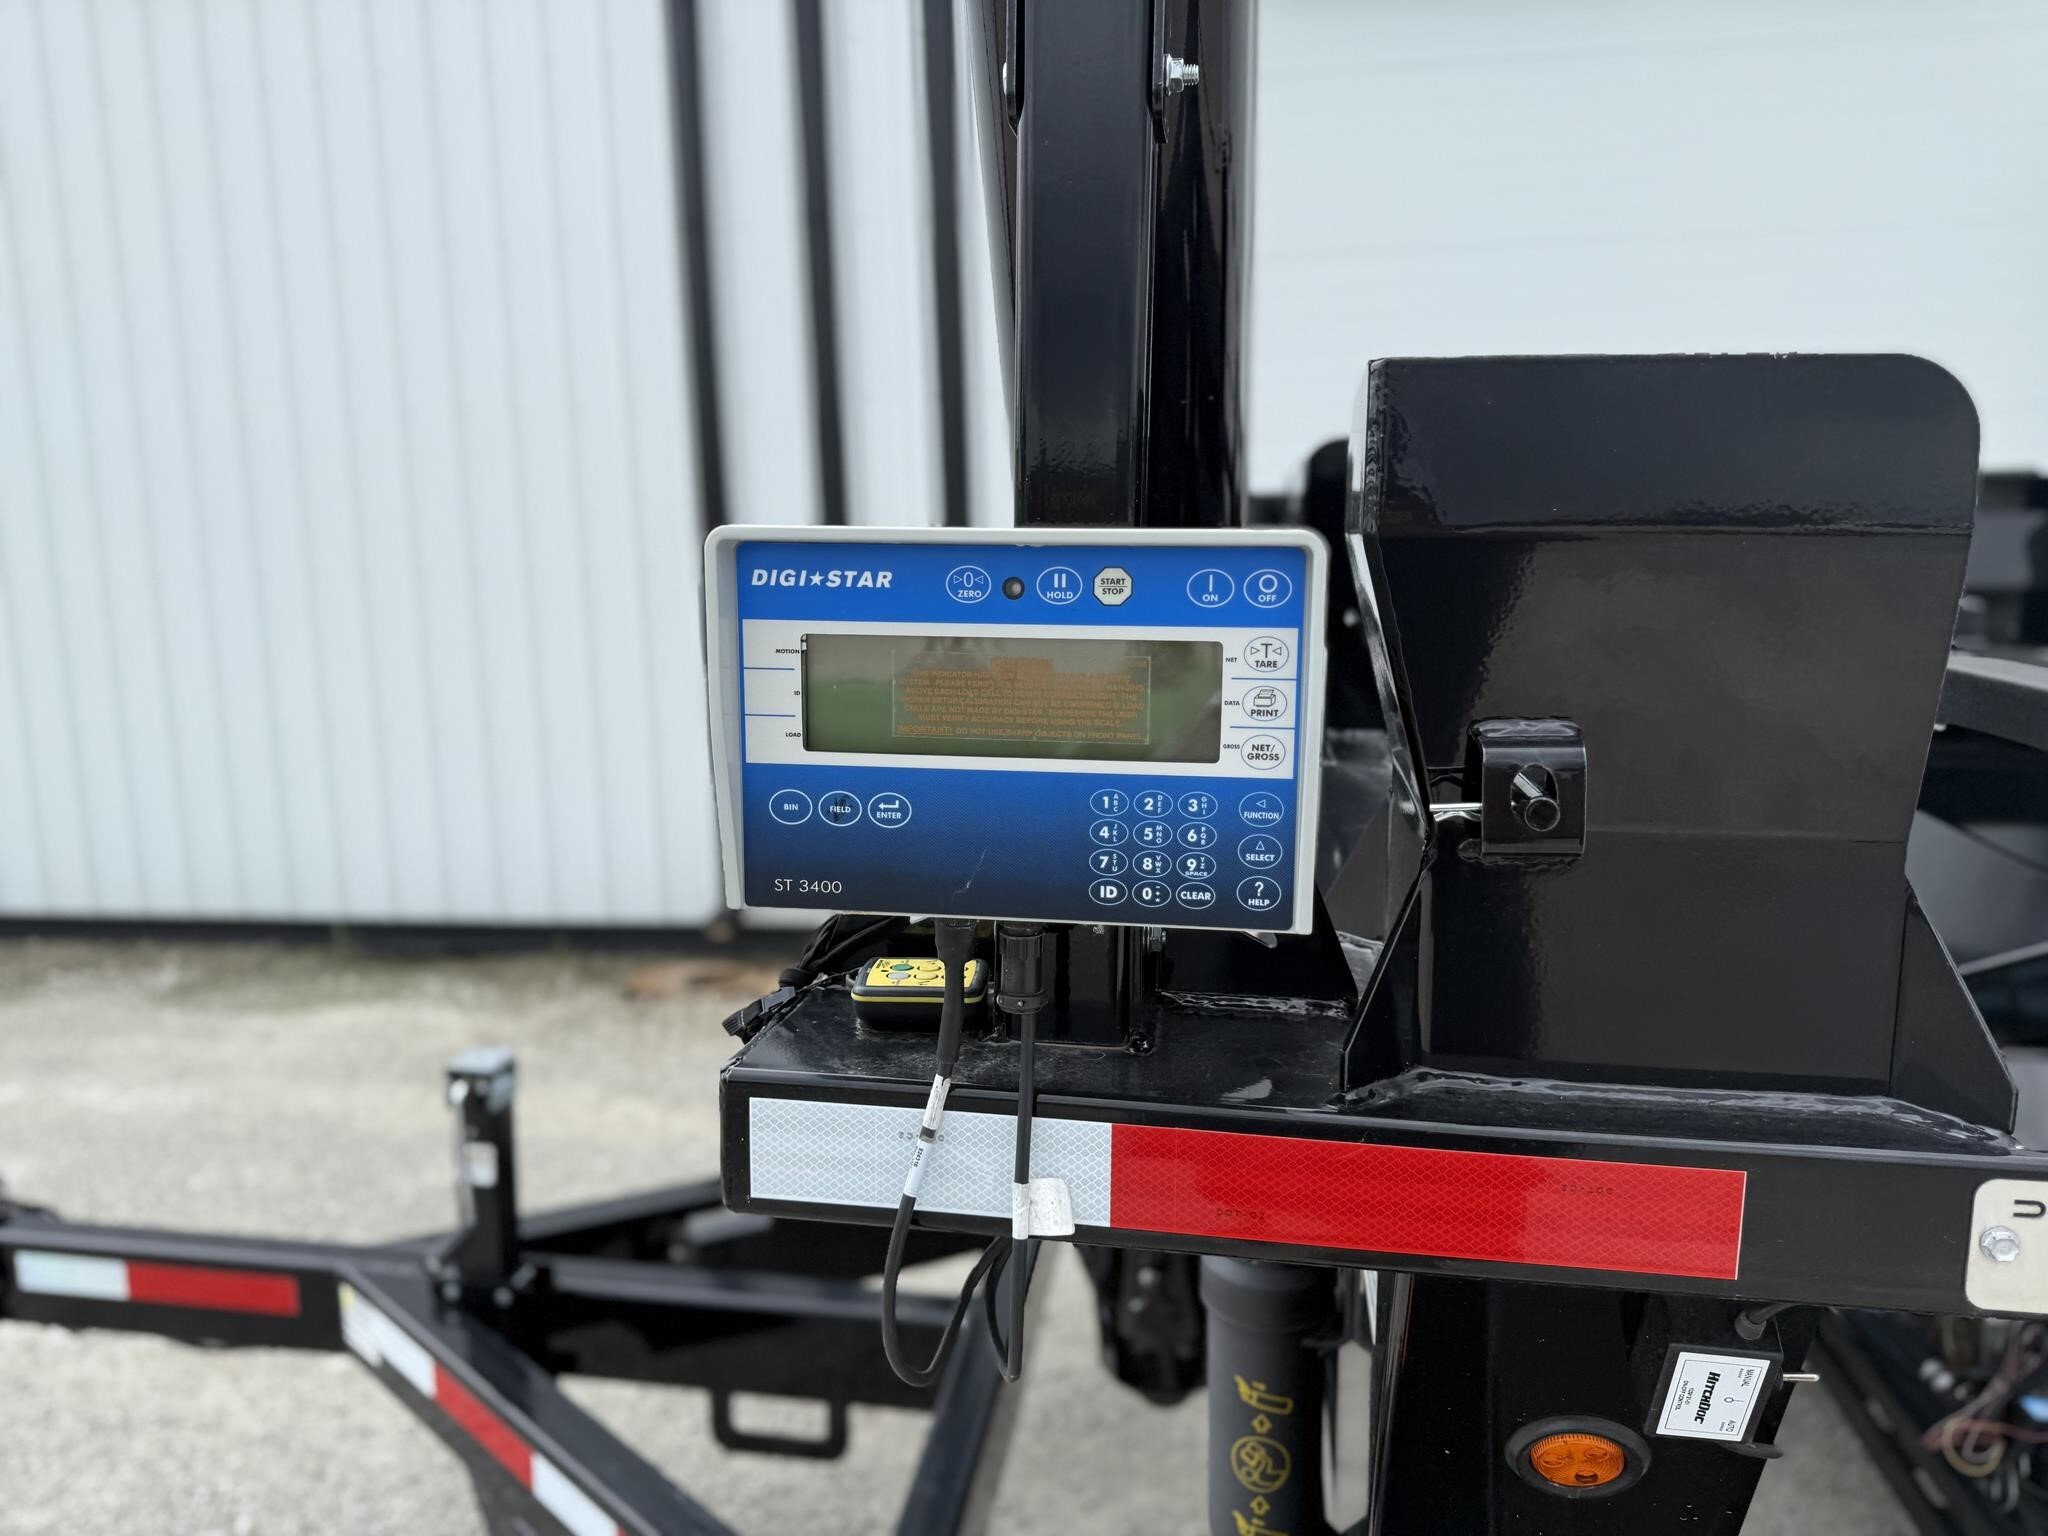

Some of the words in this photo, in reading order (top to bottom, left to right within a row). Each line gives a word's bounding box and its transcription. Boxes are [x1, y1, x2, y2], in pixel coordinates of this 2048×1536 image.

[1100, 578, 1126, 586] START
[957, 590, 982, 598] ZERO
[1047, 591, 1073, 600] HOLD
[1102, 587, 1125, 595] STOP
[1202, 594, 1218, 602] ON
[1258, 594, 1277, 603] OFF
[1255, 660, 1277, 668] TARE
[1250, 709, 1279, 717] PRINT
[1252, 744, 1275, 753] NET/
[1247, 753, 1280, 761] GROSS
[1102, 796, 1109, 809] 1
[1144, 797, 1153, 811] 2
[1188, 798, 1198, 812] 3
[829, 805, 851, 813] FIELD
[876, 811, 902, 819] ENTER
[1099, 826, 1109, 838] 4
[1143, 827, 1153, 840] 5
[1187, 829, 1197, 842] 6
[1099, 856, 1109, 868] 7
[1142, 857, 1152, 870] 8
[1186, 858, 1196, 871] 9
[774, 878, 793, 891] ST
[799, 880, 842, 893] 3400
[1100, 885, 1117, 898] ID
[1142, 887, 1152, 899] 0
[1180, 891, 1211, 900] CLEAR
[1248, 899, 1270, 907] HELP
